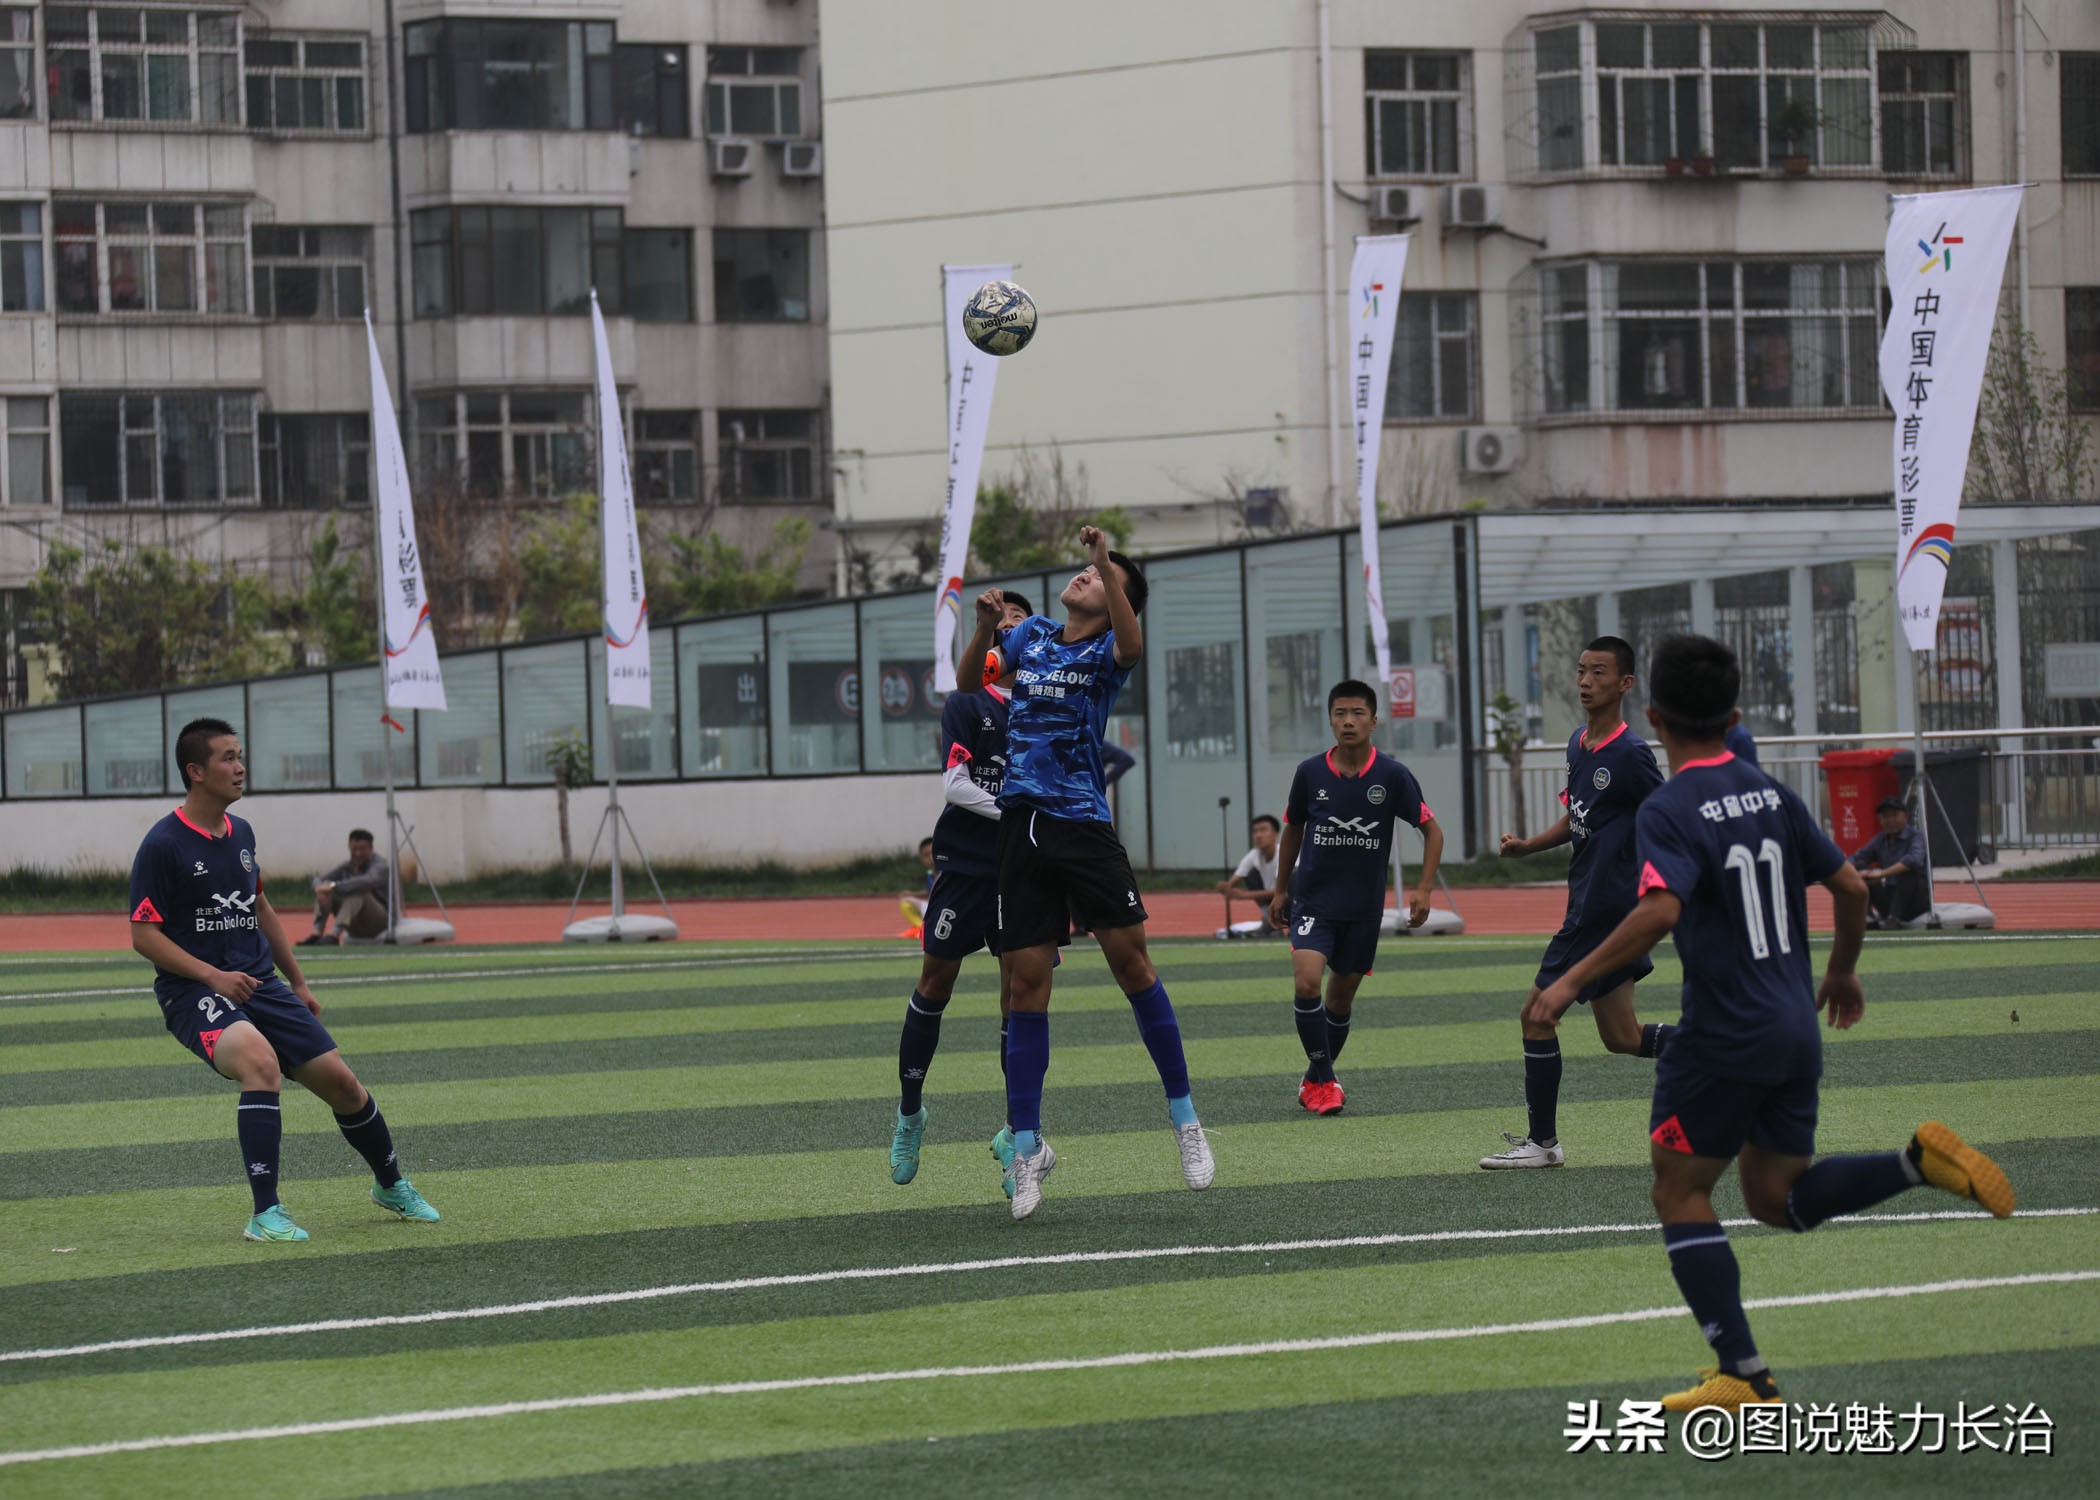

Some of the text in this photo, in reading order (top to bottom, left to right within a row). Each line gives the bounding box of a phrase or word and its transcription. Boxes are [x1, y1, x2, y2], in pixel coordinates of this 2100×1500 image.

[981, 312, 1018, 329] molten
[975, 766, 999, 776] 北正农
[1699, 788, 1782, 822] 屯留中学
[1313, 833, 1380, 850] Bznbiology
[1725, 837, 1791, 960] 11
[934, 908, 956, 941] 6
[1297, 915, 1316, 936] 3
